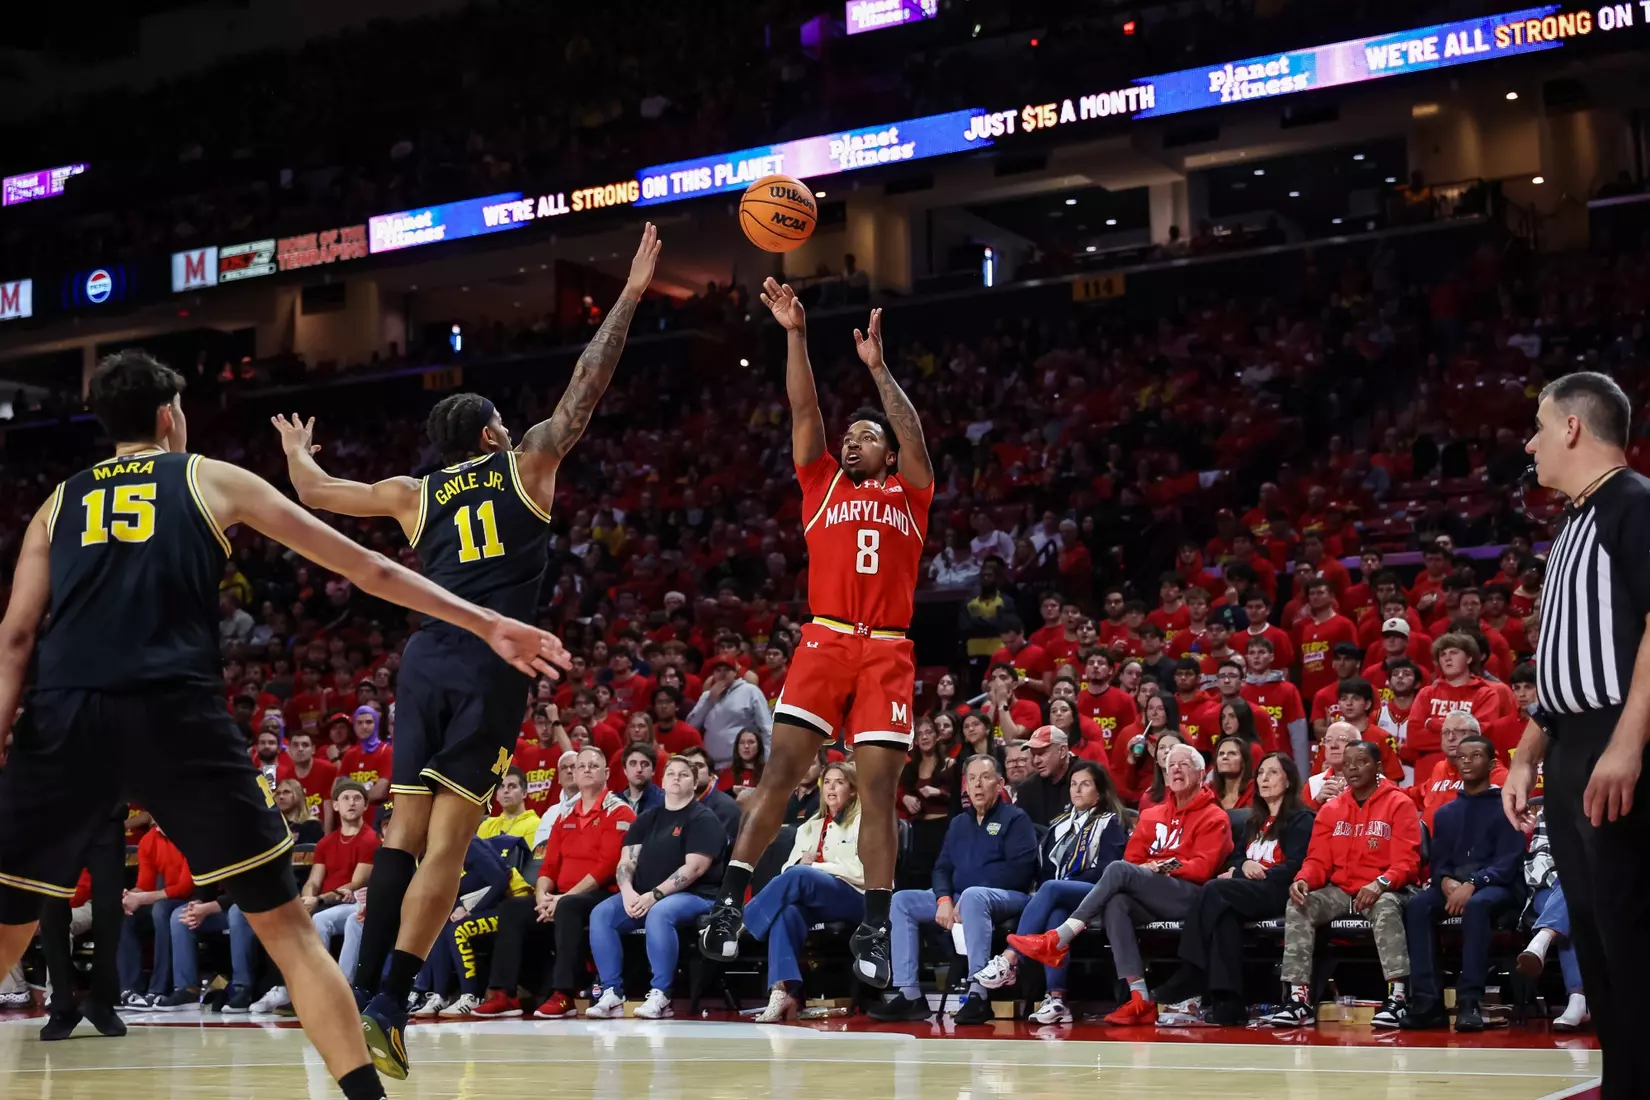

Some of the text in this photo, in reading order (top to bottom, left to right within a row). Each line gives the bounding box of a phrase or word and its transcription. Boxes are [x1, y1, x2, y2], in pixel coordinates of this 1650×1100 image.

[1365, 36, 1440, 70] WE'RE
[1444, 28, 1491, 58] ALL
[1494, 10, 1592, 49] STRONG
[1598, 3, 1633, 31] ON
[1208, 55, 1290, 92] planet
[1221, 73, 1309, 102] fitness
[964, 84, 1155, 141] JUST $15 A MONTH
[829, 126, 899, 159] planet
[840, 142, 915, 169] fitness
[482, 155, 785, 227] WE'RE ALL STRONG ON THIS PLANET
[769, 186, 815, 213] Wilson
[377, 211, 432, 239] planet
[771, 212, 807, 233] NCAA
[184, 251, 206, 284] M
[0, 282, 20, 315] M
[92, 460, 155, 481] MARA
[435, 471, 505, 505] GAYLE JR.
[81, 482, 157, 547] 15
[824, 500, 909, 537] MARYLAND
[454, 500, 505, 564] 11
[855, 528, 880, 574] 8
[891, 701, 907, 724] M
[490, 746, 514, 780] M
